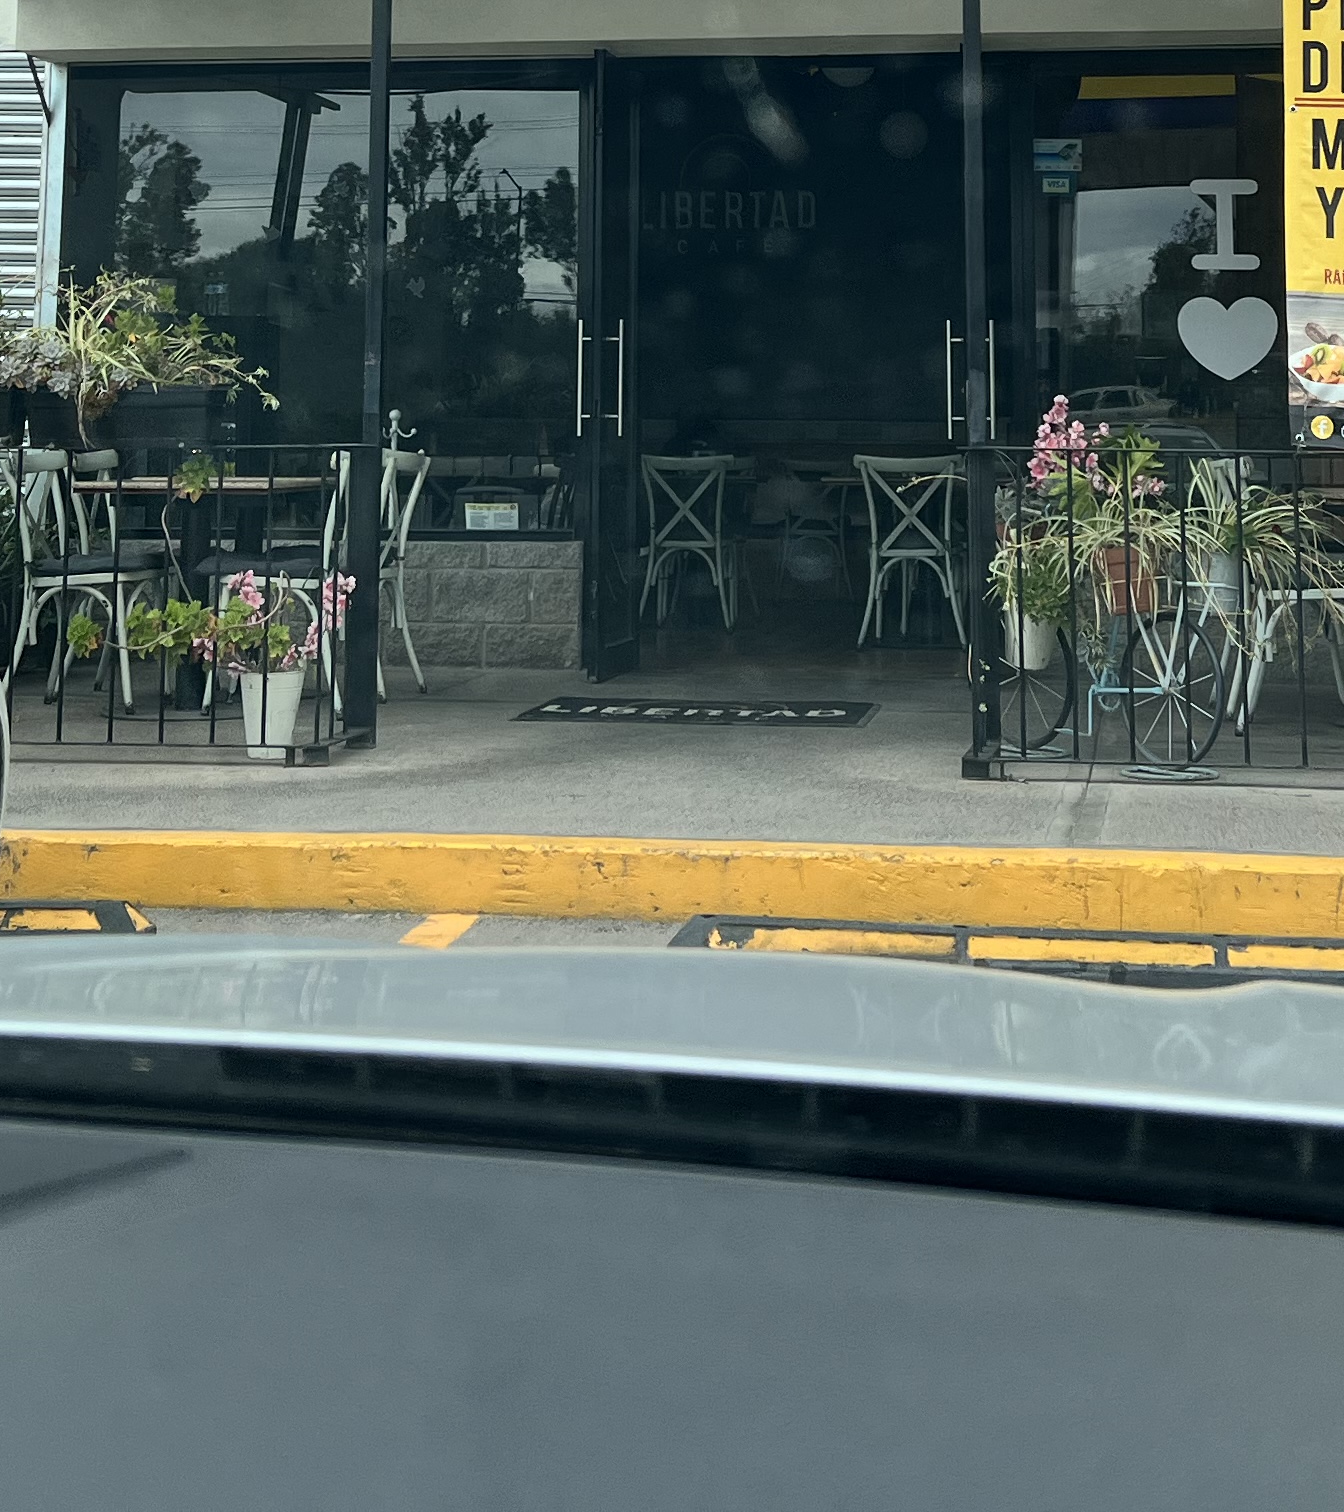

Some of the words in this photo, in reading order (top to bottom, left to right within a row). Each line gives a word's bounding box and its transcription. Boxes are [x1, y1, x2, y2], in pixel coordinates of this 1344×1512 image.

[1047, 180, 1066, 188] VISA
[642, 190, 818, 230] LIBERTAD
[1190, 179, 1261, 271] I
[1315, 186, 1344, 239] Y
